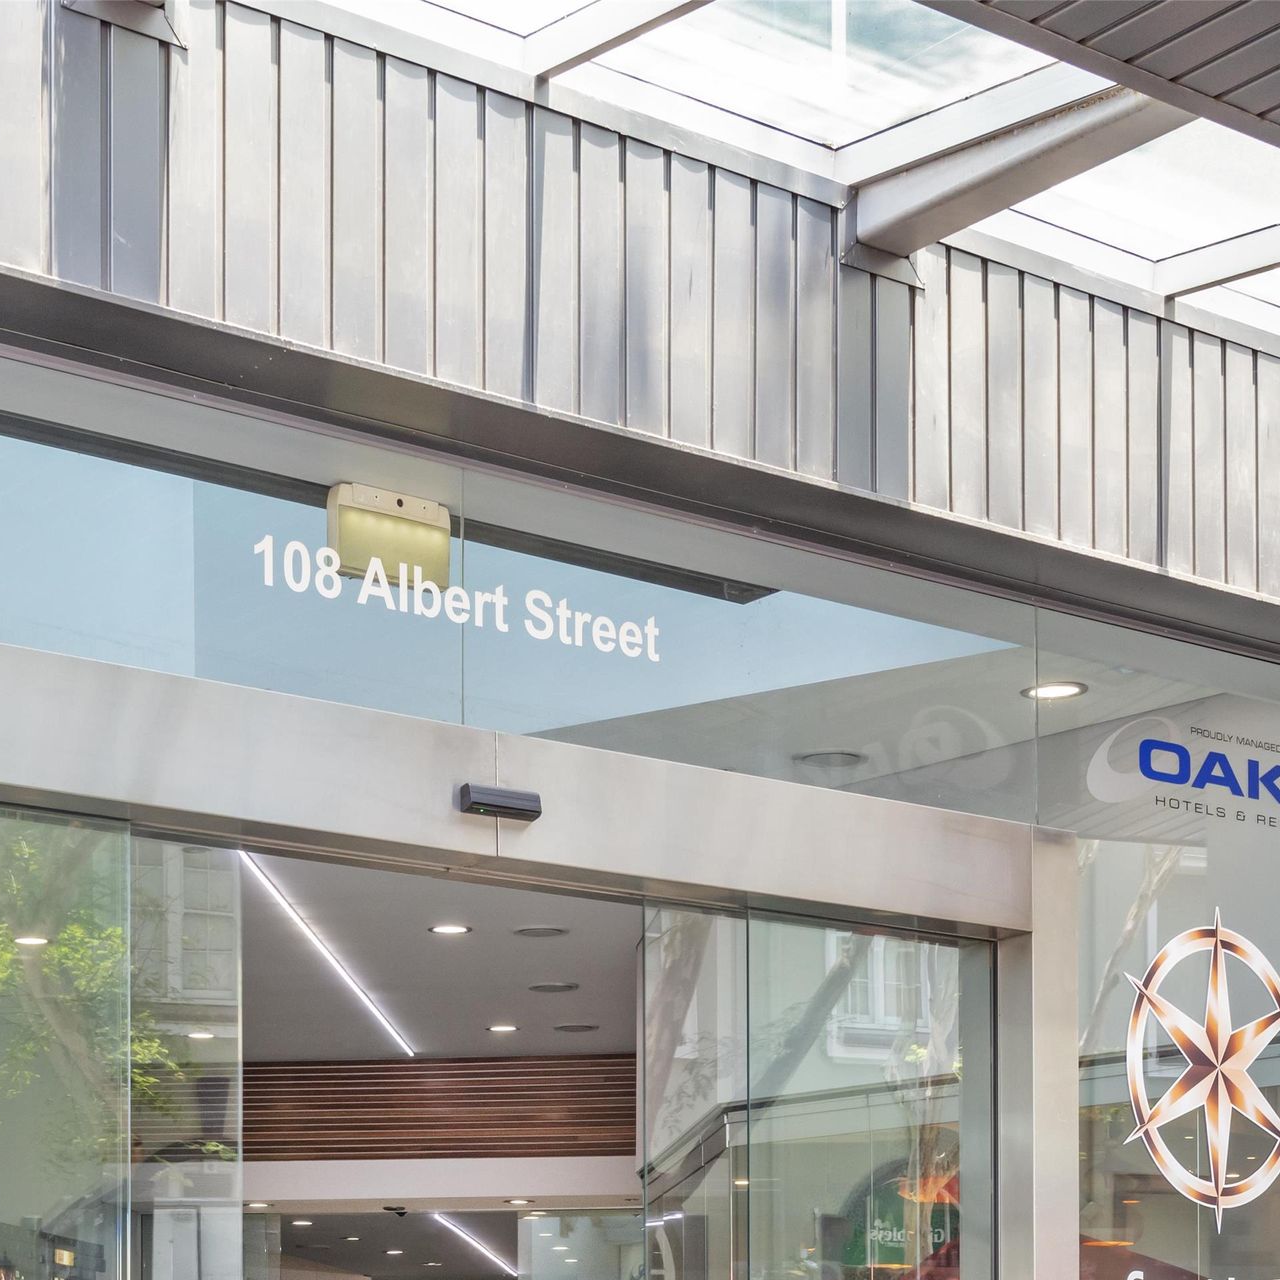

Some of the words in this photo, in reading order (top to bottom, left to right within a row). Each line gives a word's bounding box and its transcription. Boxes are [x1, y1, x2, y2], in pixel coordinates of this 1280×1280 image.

[253, 535, 341, 599] 108
[357, 557, 508, 633] Albert
[525, 589, 660, 662] Street
[1191, 726, 1233, 745] PROUDLY
[1155, 795, 1229, 819] HOTELS
[1236, 811, 1247, 822] &
